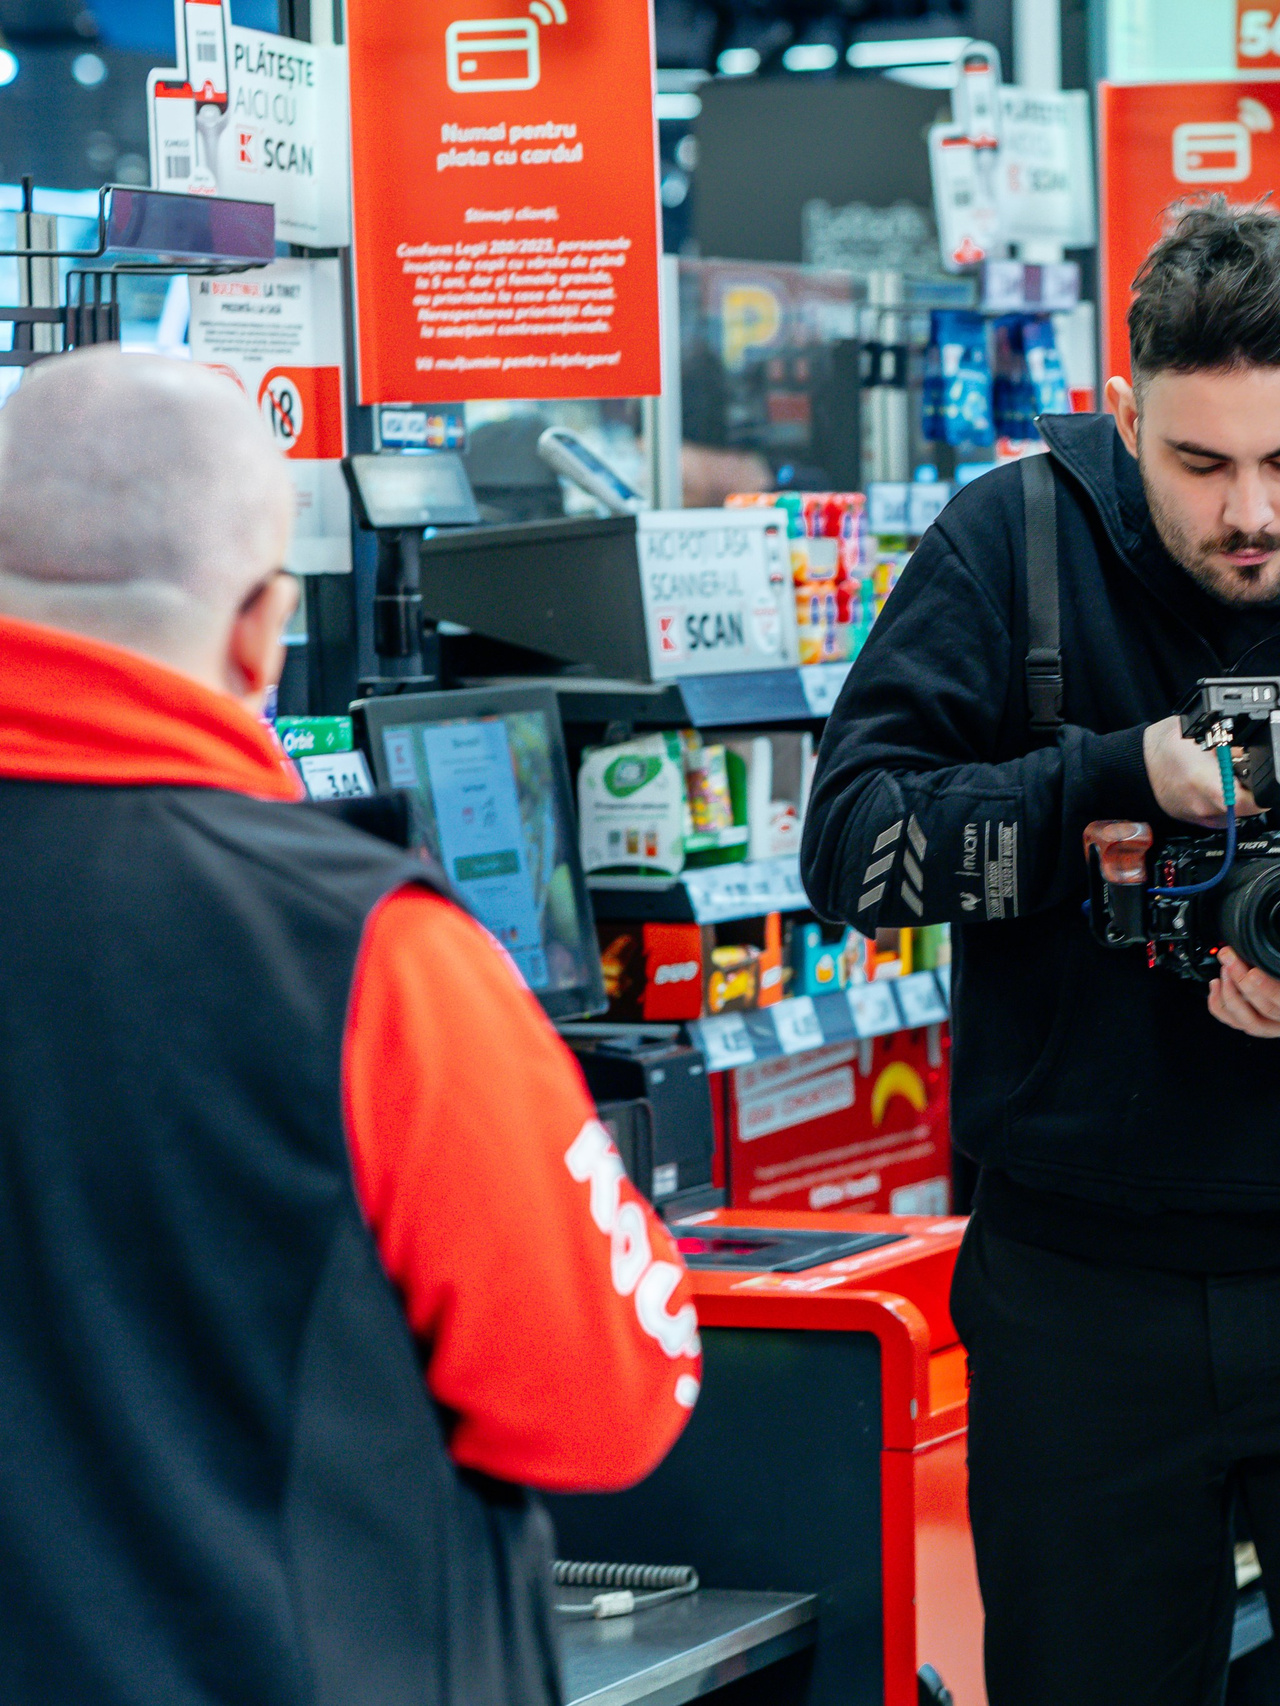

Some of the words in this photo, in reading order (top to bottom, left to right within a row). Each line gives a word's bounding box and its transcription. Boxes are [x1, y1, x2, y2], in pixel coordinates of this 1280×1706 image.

[233, 86, 269, 120] AICI
[273, 93, 297, 126] CU
[441, 122, 507, 144] Numai
[509, 120, 577, 145] pentru
[264, 137, 314, 177] SCAN
[436, 148, 490, 172] plata
[493, 149, 518, 166] cu
[520, 142, 584, 165] cardul
[686, 613, 744, 649] SCAN
[283, 730, 316, 753] Orbit
